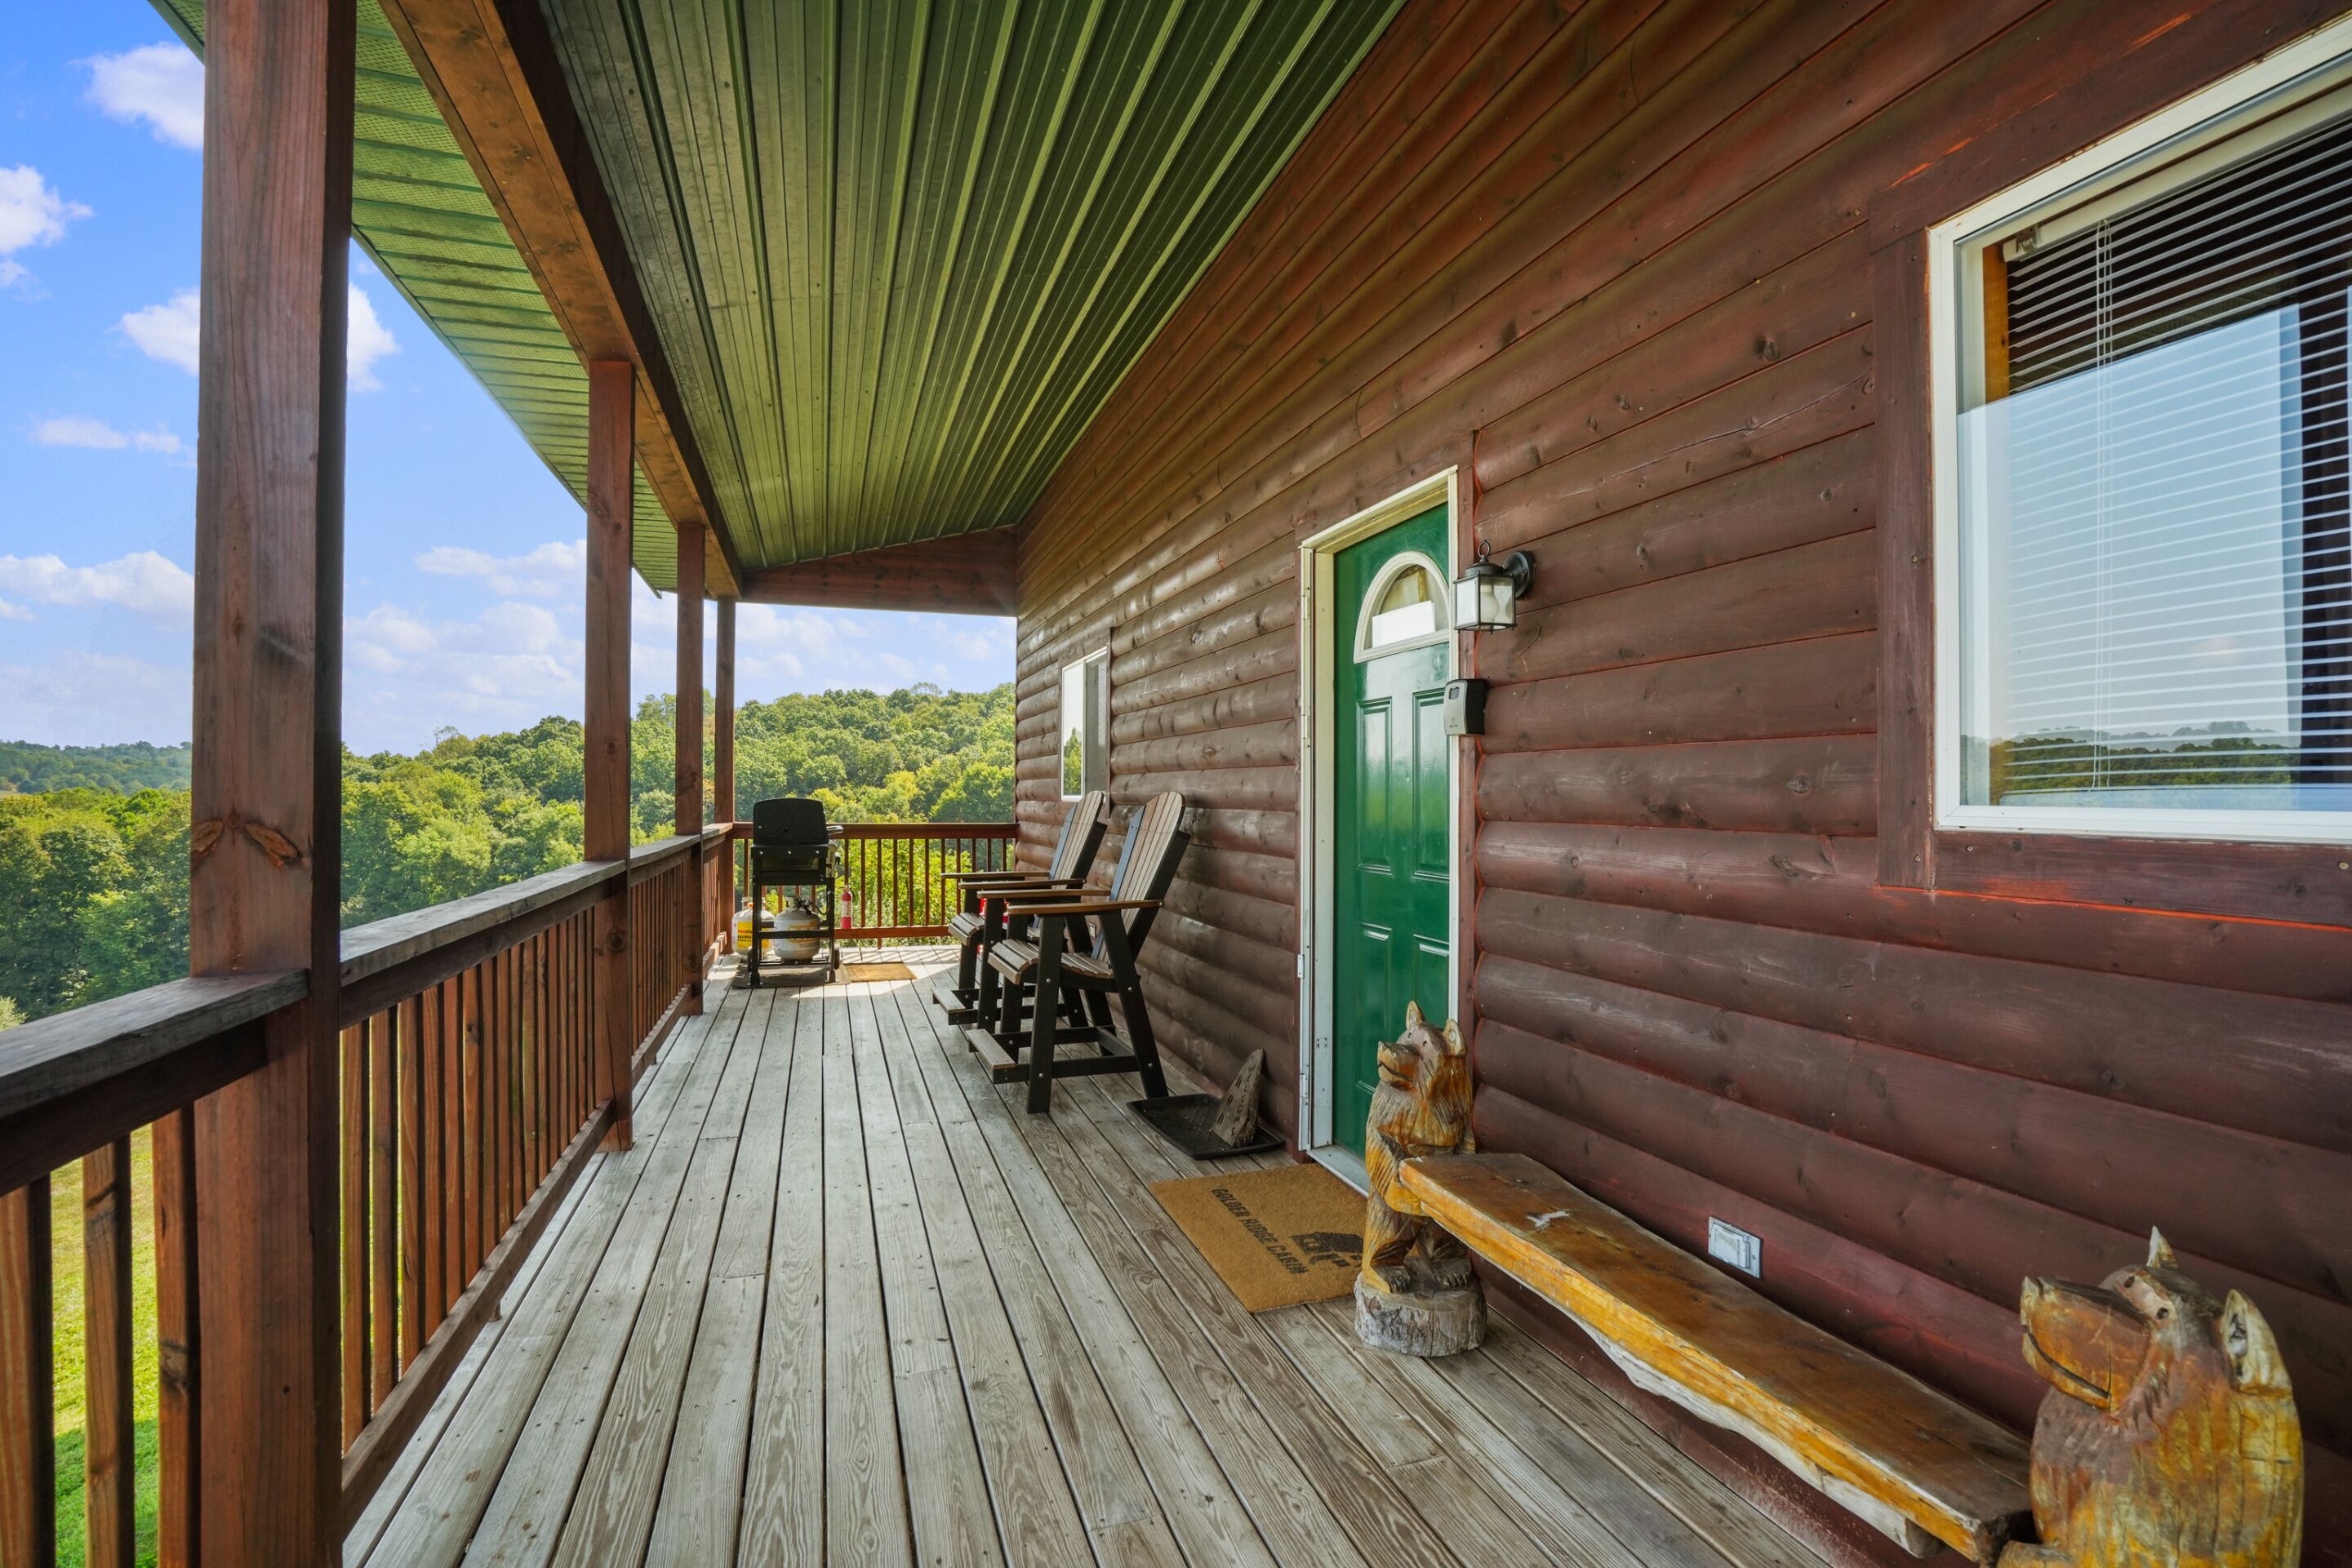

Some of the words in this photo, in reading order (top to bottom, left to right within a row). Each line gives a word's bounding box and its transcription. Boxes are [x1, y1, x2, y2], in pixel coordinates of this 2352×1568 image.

[1231, 1063, 1256, 1136] WELCOME
[1212, 1188, 1252, 1217] GOLDEN
[1240, 1219, 1278, 1244] RIDGE
[1268, 1245, 1309, 1274] CABIN
